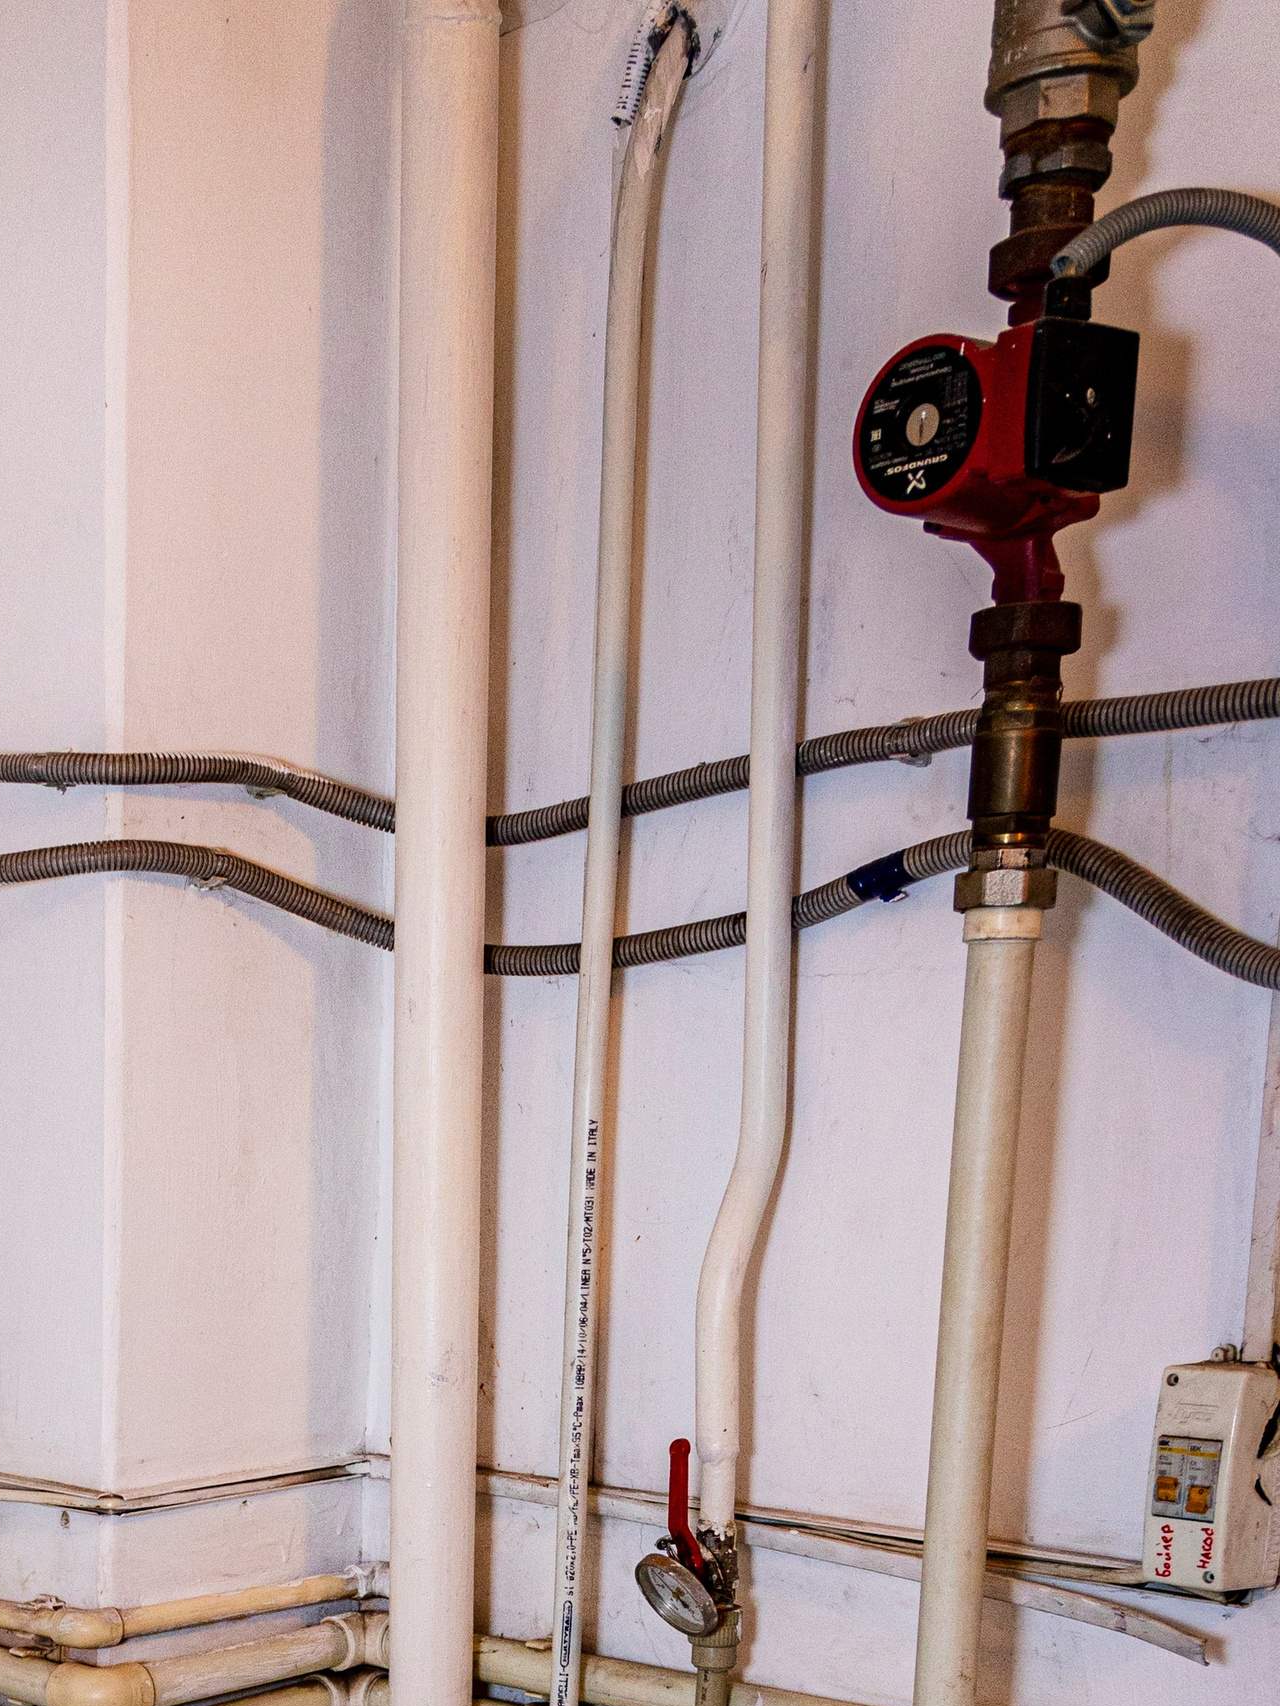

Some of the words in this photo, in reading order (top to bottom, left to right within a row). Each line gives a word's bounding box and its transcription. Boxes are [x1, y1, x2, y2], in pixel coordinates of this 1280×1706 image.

[886, 453, 948, 476] GRUNDFOS
[587, 1119, 599, 1146] ITALY
[587, 1151, 597, 1162] IN
[585, 1168, 596, 1190] MADE
